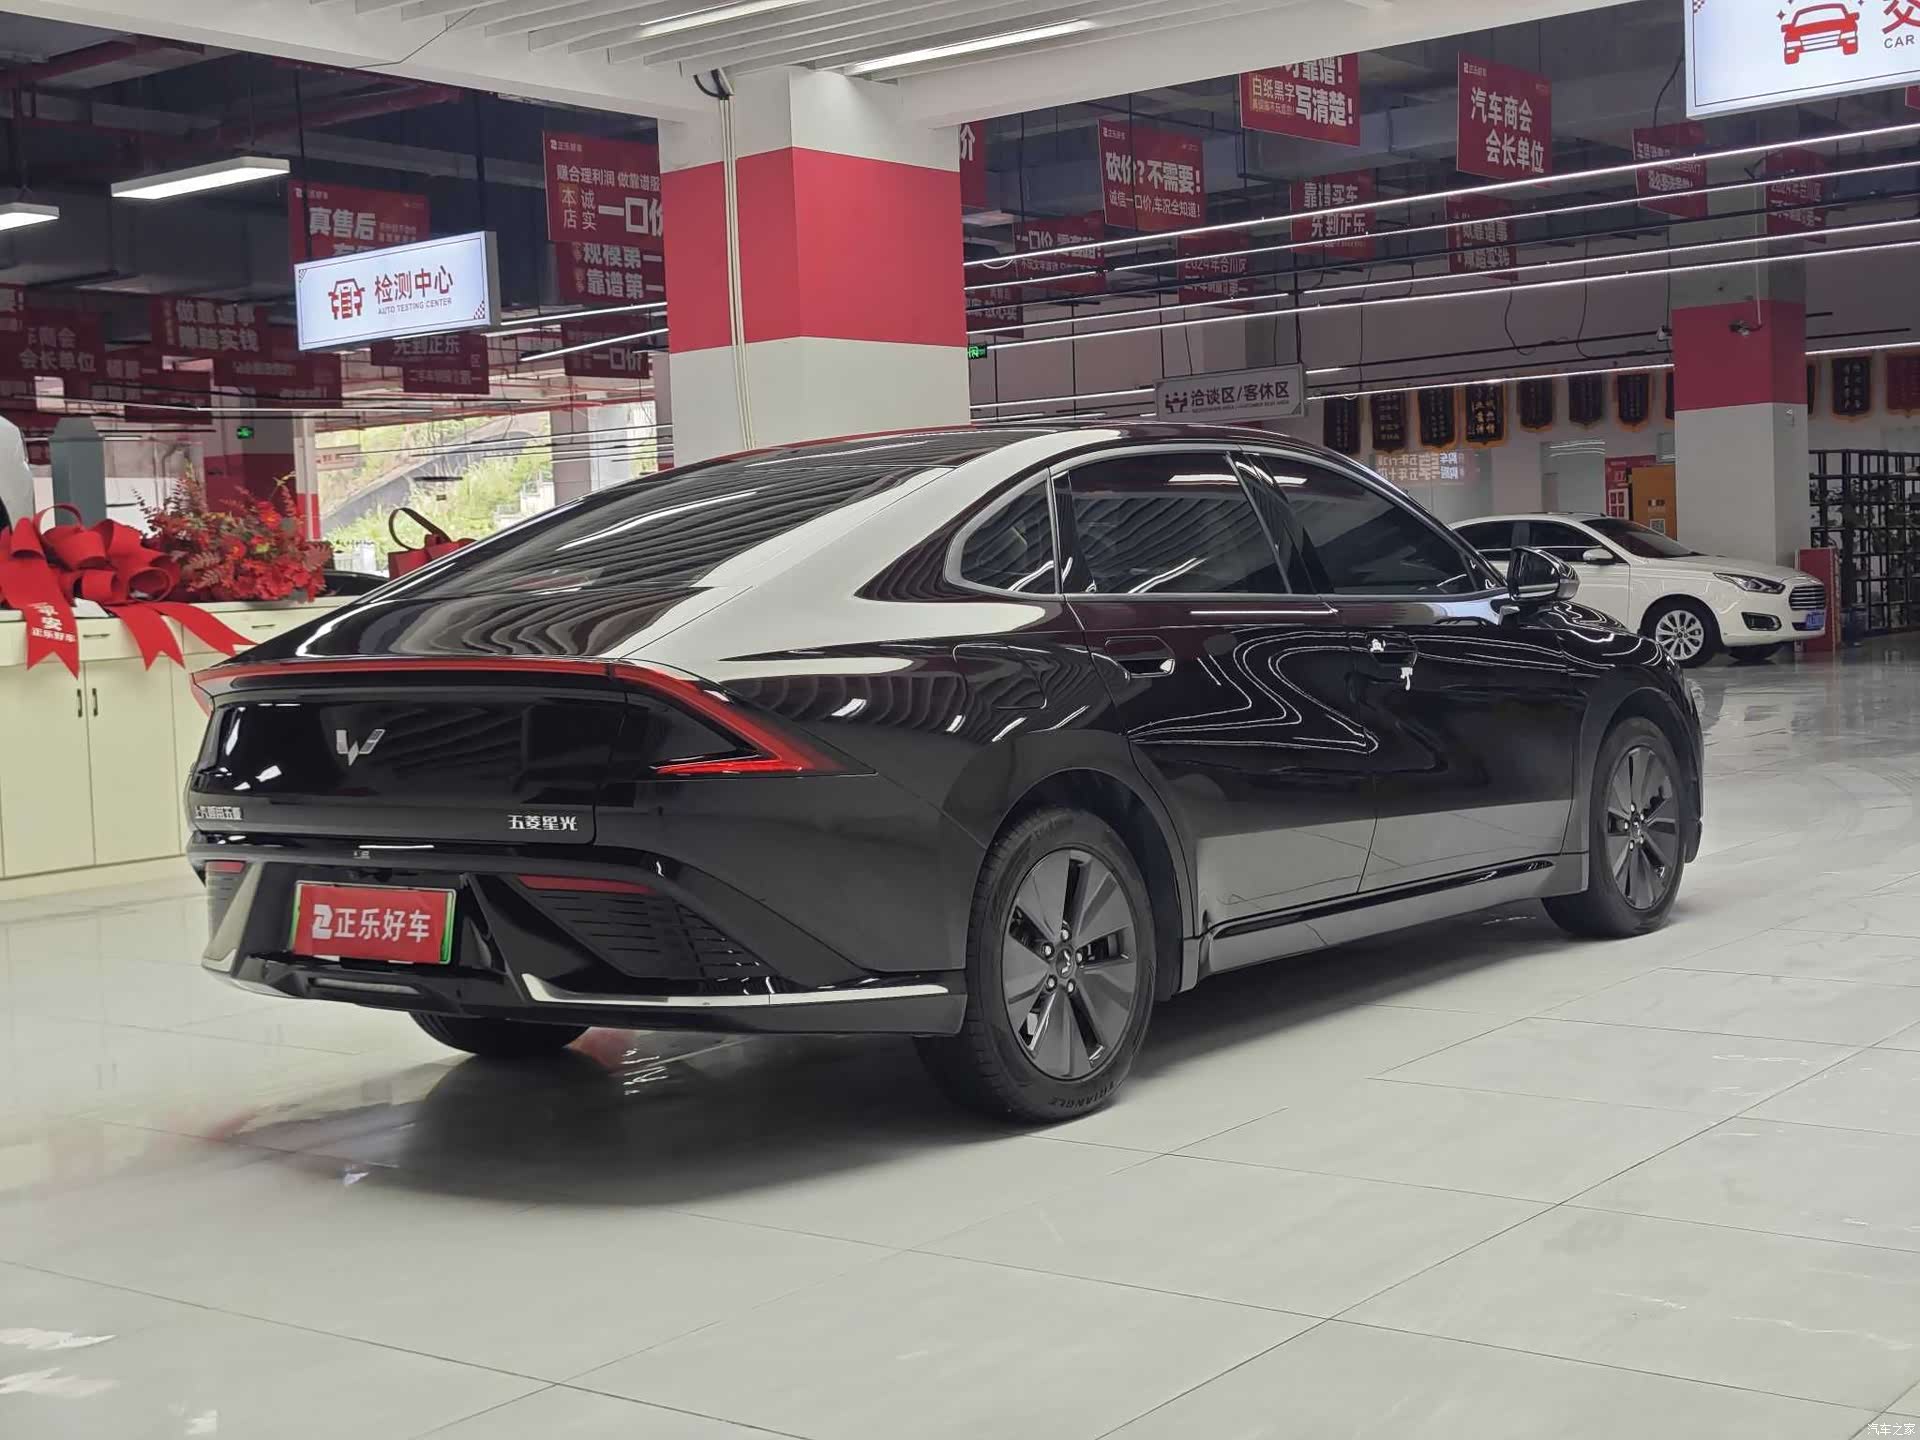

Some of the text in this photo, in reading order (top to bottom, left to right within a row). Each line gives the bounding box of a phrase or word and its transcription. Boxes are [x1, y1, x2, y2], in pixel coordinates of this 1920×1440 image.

[1884, 35, 1915, 49] CAR
[1252, 75, 1353, 126] 白纸黑字 写清楚！
[1471, 86, 1533, 133] 汽车商会
[1486, 128, 1544, 173] 会长单位
[562, 186, 578, 230] 本店
[1303, 181, 1359, 208] 靠谱买车
[309, 207, 376, 241] 真售后
[1311, 211, 1366, 237] 先到正乐
[583, 242, 663, 269] 规模第一
[374, 265, 454, 304] 检测中心
[586, 268, 665, 299] 靠谱第一
[378, 297, 453, 315] AUTO TESTING CENTER
[19, 349, 97, 373] 会长单位
[1191, 381, 1290, 407] 洽谈区/客休区
[507, 815, 579, 832] 五菱星光
[333, 907, 431, 943] 正乐好车
